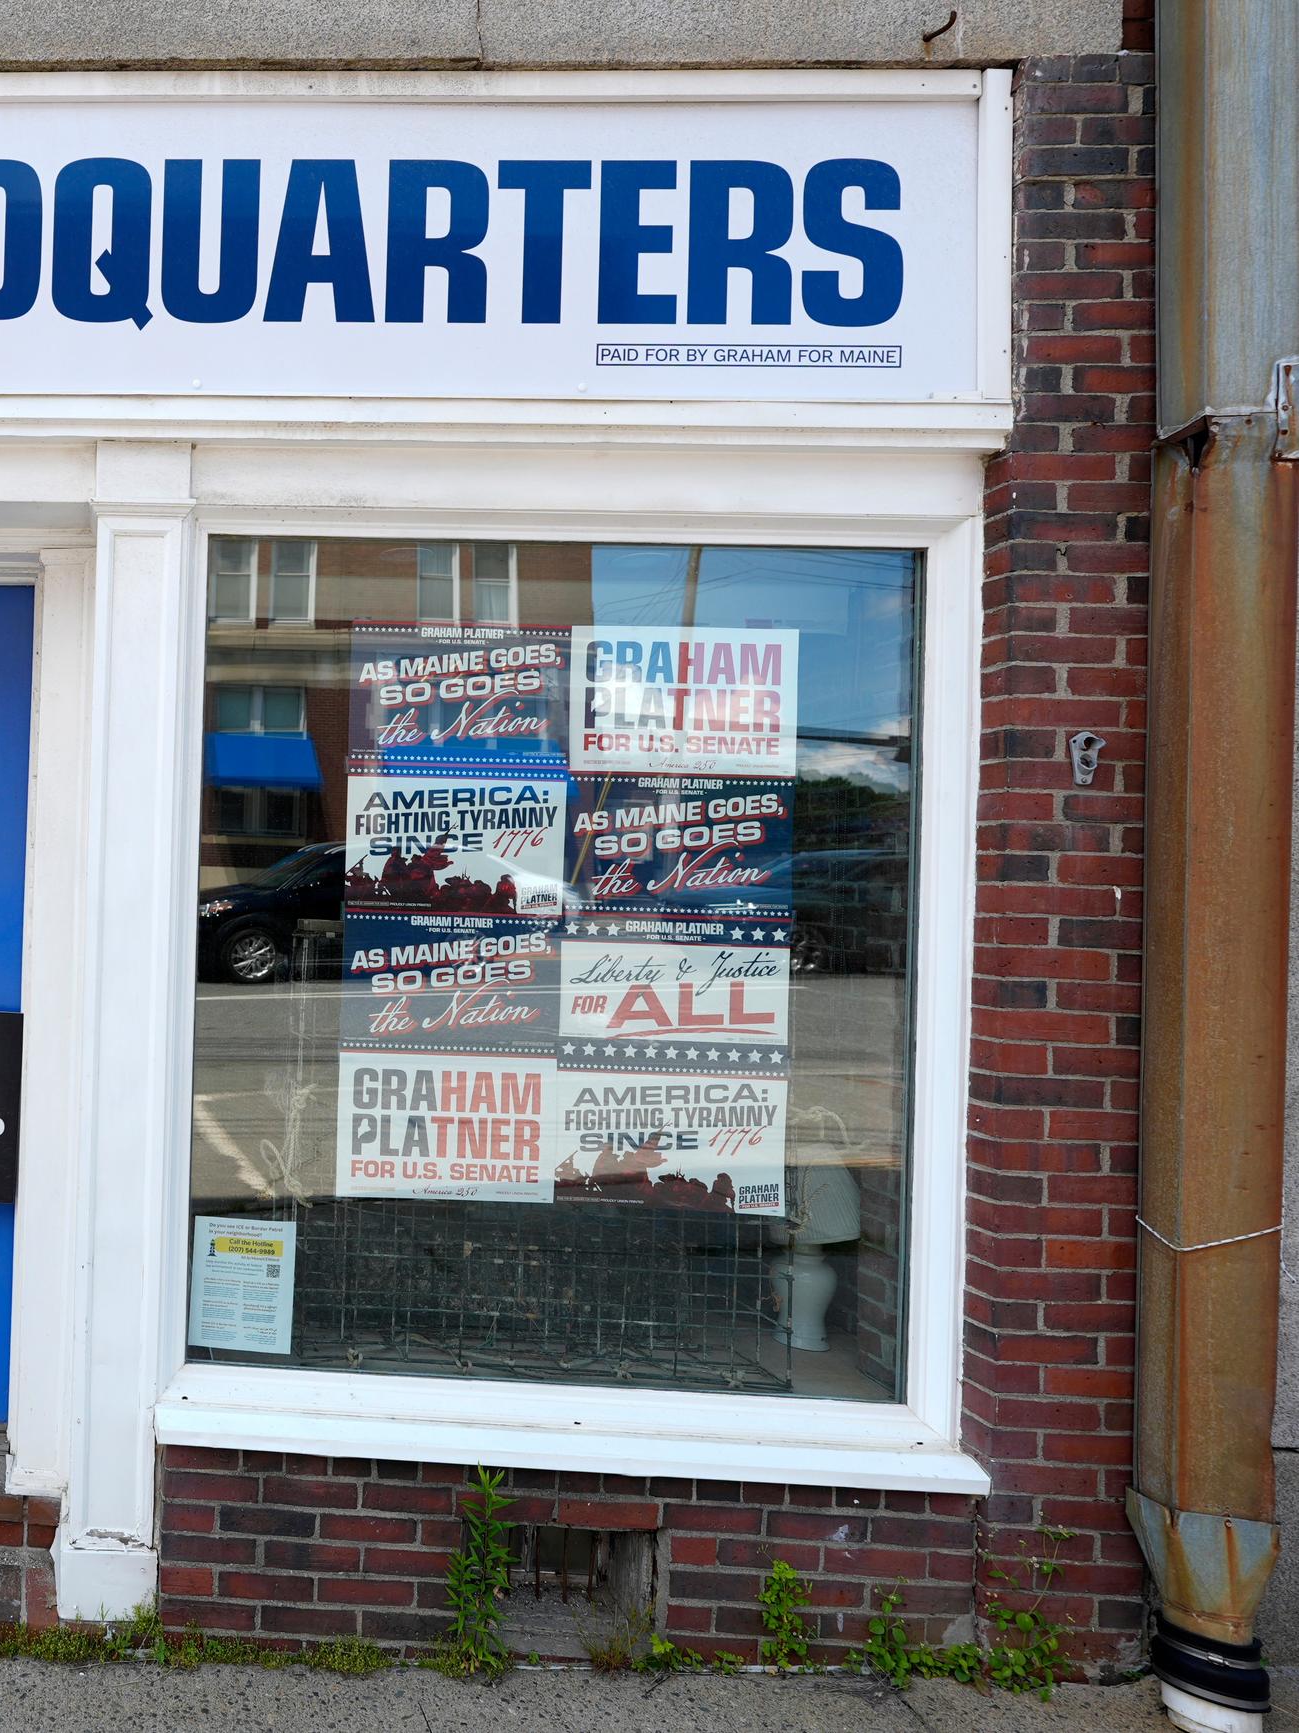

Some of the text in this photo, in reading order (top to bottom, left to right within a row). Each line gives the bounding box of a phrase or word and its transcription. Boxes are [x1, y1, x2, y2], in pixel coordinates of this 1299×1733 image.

[600, 349, 897, 363] PAID FOR BY GRAHAM FOR MAINE
[421, 627, 504, 639] GRAHAM PLATNER
[359, 643, 562, 683] AS MAINE GOES,
[586, 640, 782, 686] GRAHAM
[379, 670, 542, 706] SO GOES
[377, 688, 547, 745] the Nation
[584, 687, 781, 733] PLATNER
[583, 733, 780, 755] FOR U.S. SENATE
[363, 785, 549, 811] AMERICA:
[638, 777, 723, 790] GRAHAM PLATNER
[355, 806, 558, 835] FIGHTING TYRANNY
[573, 793, 784, 833] AS MAINE GOES,
[369, 826, 548, 857] SINCE 1776
[594, 821, 762, 856] SO GOES
[591, 839, 768, 896] the Nation
[521, 892, 558, 904] PLATNER
[411, 915, 493, 928] GRAHAM PLATNER
[626, 921, 724, 935] GRAHAM PLATNER
[350, 931, 551, 970] AS MAINE GOES,
[371, 959, 531, 993] SO GOES
[569, 950, 781, 997] Liberty & Justice
[368, 978, 538, 1033] the Nation
[571, 981, 775, 1028] FOR ALL
[353, 1068, 541, 1115] GRAHAM
[573, 1083, 769, 1107] AMERICA:
[564, 1104, 778, 1131] FIGHTING TYRANNY
[352, 1113, 540, 1162] PLATNER
[579, 1125, 767, 1156] SINCE 1776
[351, 1160, 539, 1183] FOR U.S. SENATE
[739, 1184, 779, 1195] GRAHAM
[739, 1193, 779, 1204] PLATNER
